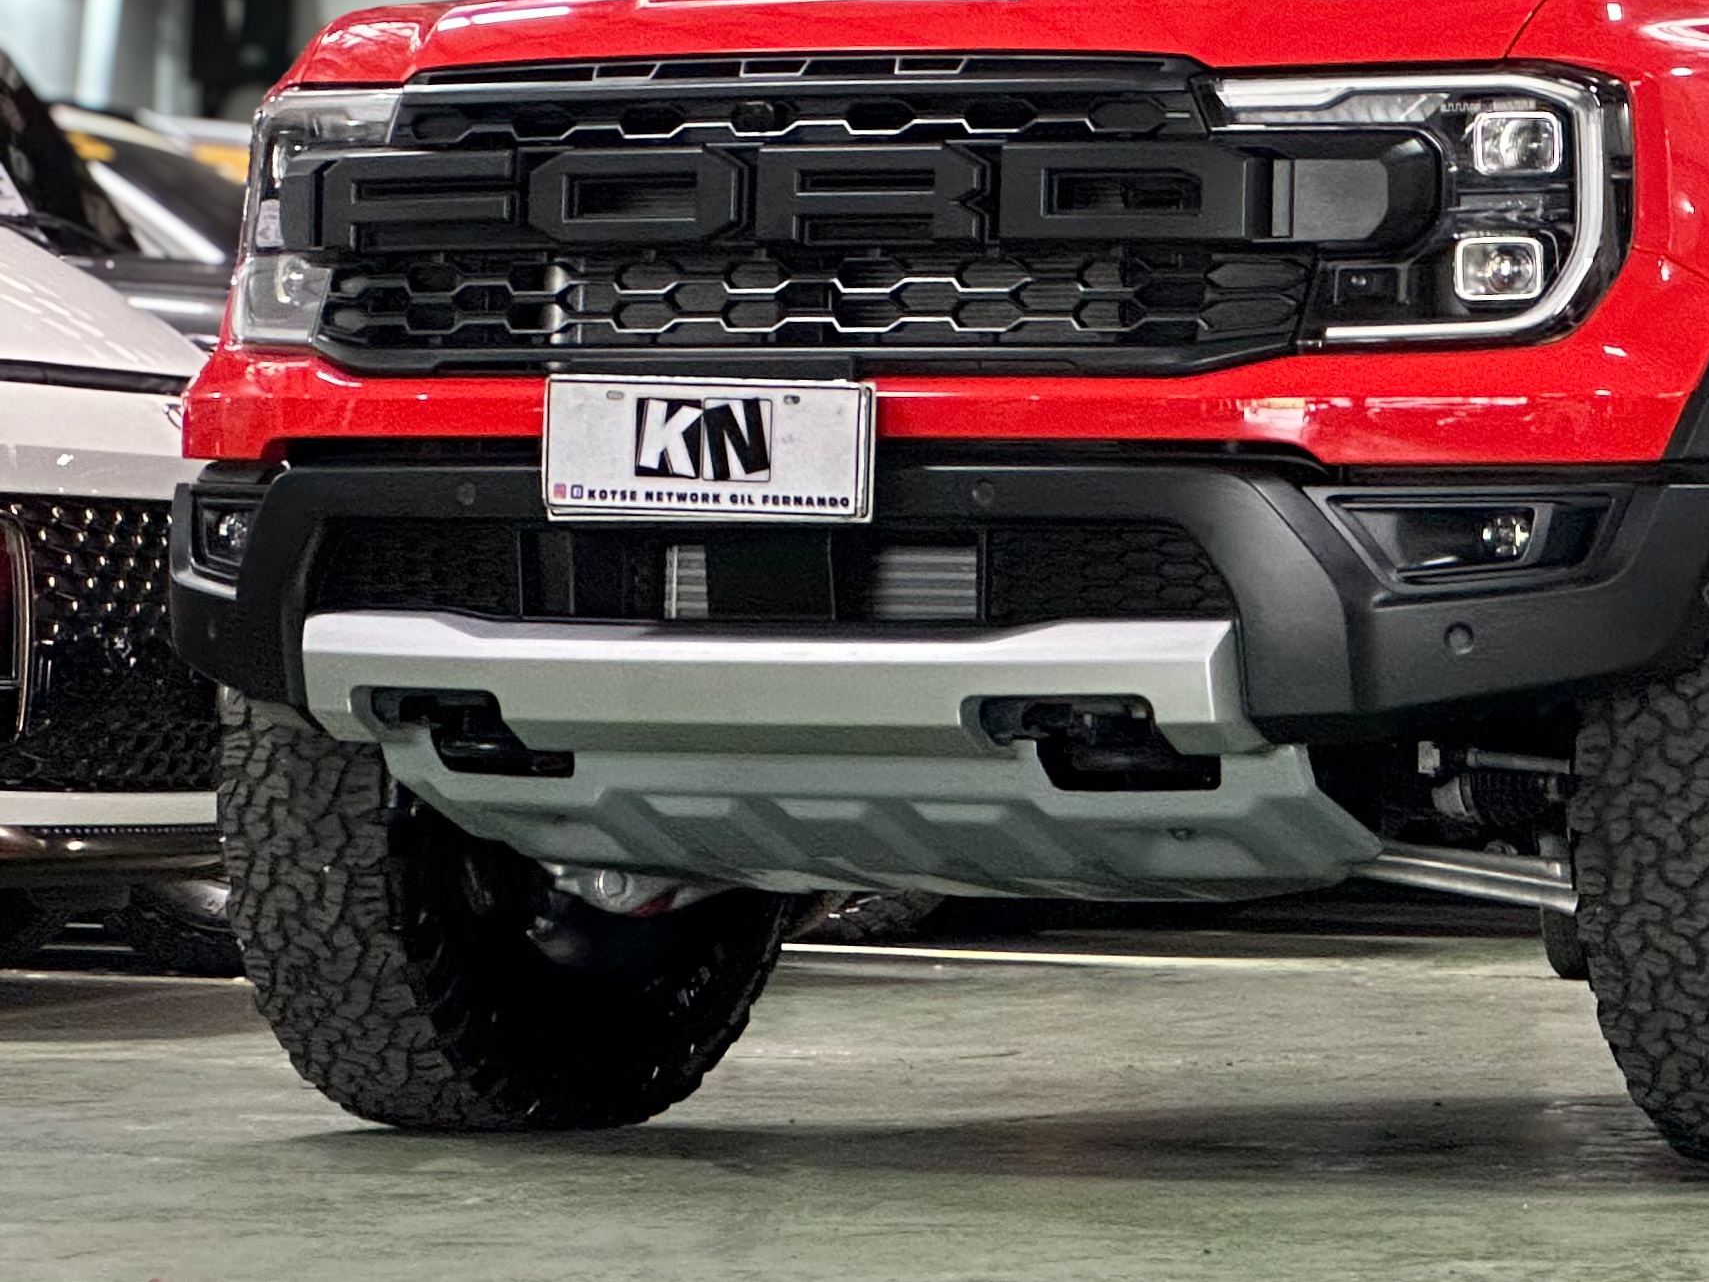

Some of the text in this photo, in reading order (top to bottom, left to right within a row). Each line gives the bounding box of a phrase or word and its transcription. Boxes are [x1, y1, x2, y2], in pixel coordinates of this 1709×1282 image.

[318, 142, 1248, 248] FORD
[638, 397, 770, 480] KN
[588, 489, 850, 509] KOTSE NETWORK GIL FERNANDO
